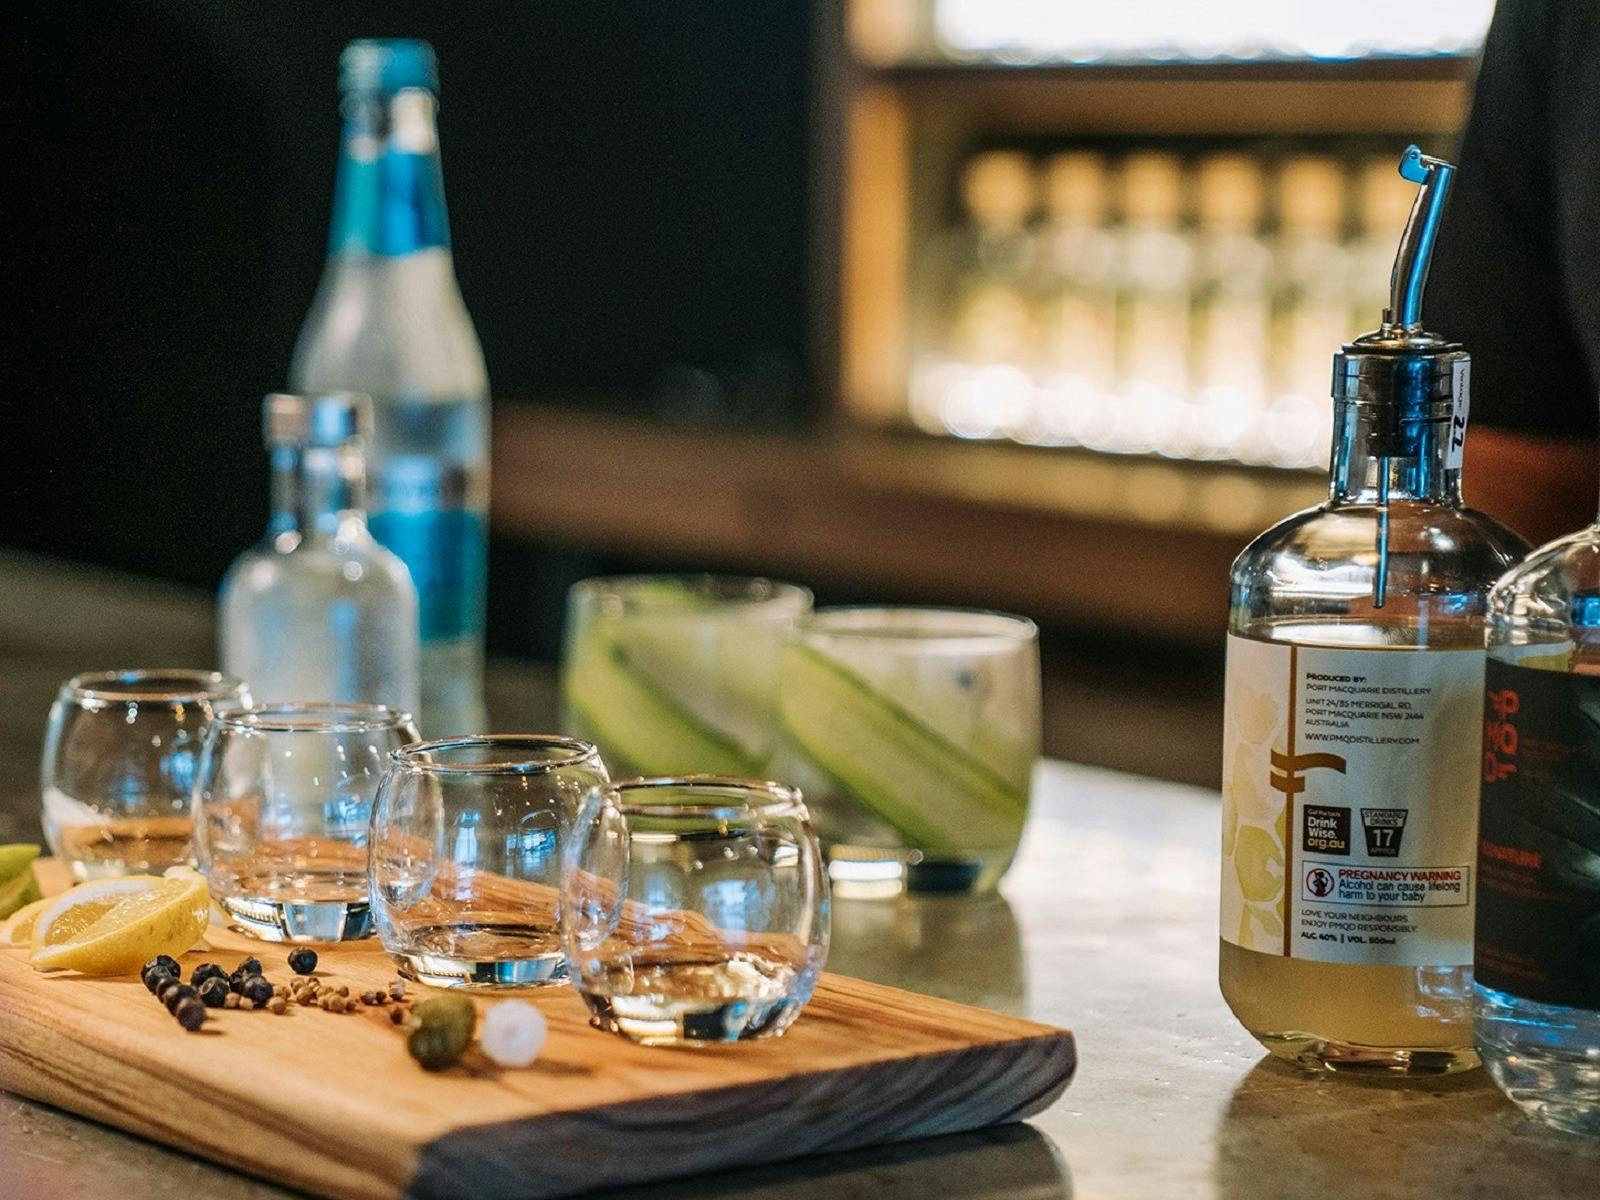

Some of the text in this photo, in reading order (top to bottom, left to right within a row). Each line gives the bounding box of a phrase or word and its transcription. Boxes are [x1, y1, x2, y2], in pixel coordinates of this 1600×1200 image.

[1306, 673, 1351, 682] PRODUCED
[1306, 683, 1432, 695] PORT MACQUARIE DISTILLERY
[1305, 708, 1327, 716] PORT
[1328, 710, 1380, 720] MACQUARIE
[1382, 712, 1403, 720] NSW
[1305, 719, 1350, 728] AUSTRALIA
[1364, 811, 1403, 819] STANDARD
[1307, 816, 1337, 828] Drink
[1370, 817, 1398, 826] DRINKS
[1308, 827, 1337, 839] Wise.
[1373, 829, 1394, 847] 17
[1307, 838, 1345, 849] org.au
[1339, 869, 1461, 881] PREGNANCY WARNING
[1339, 879, 1460, 893] Alcohol can cause lifelong
[1339, 889, 1425, 903] harm to your baby
[1301, 909, 1322, 918] LOVE
[1323, 911, 1347, 920] YOUR
[1301, 919, 1327, 928] ENJOY
[1329, 921, 1356, 931] PMQD
[1319, 934, 1337, 942] 40%
[1369, 936, 1396, 944] 500ml
